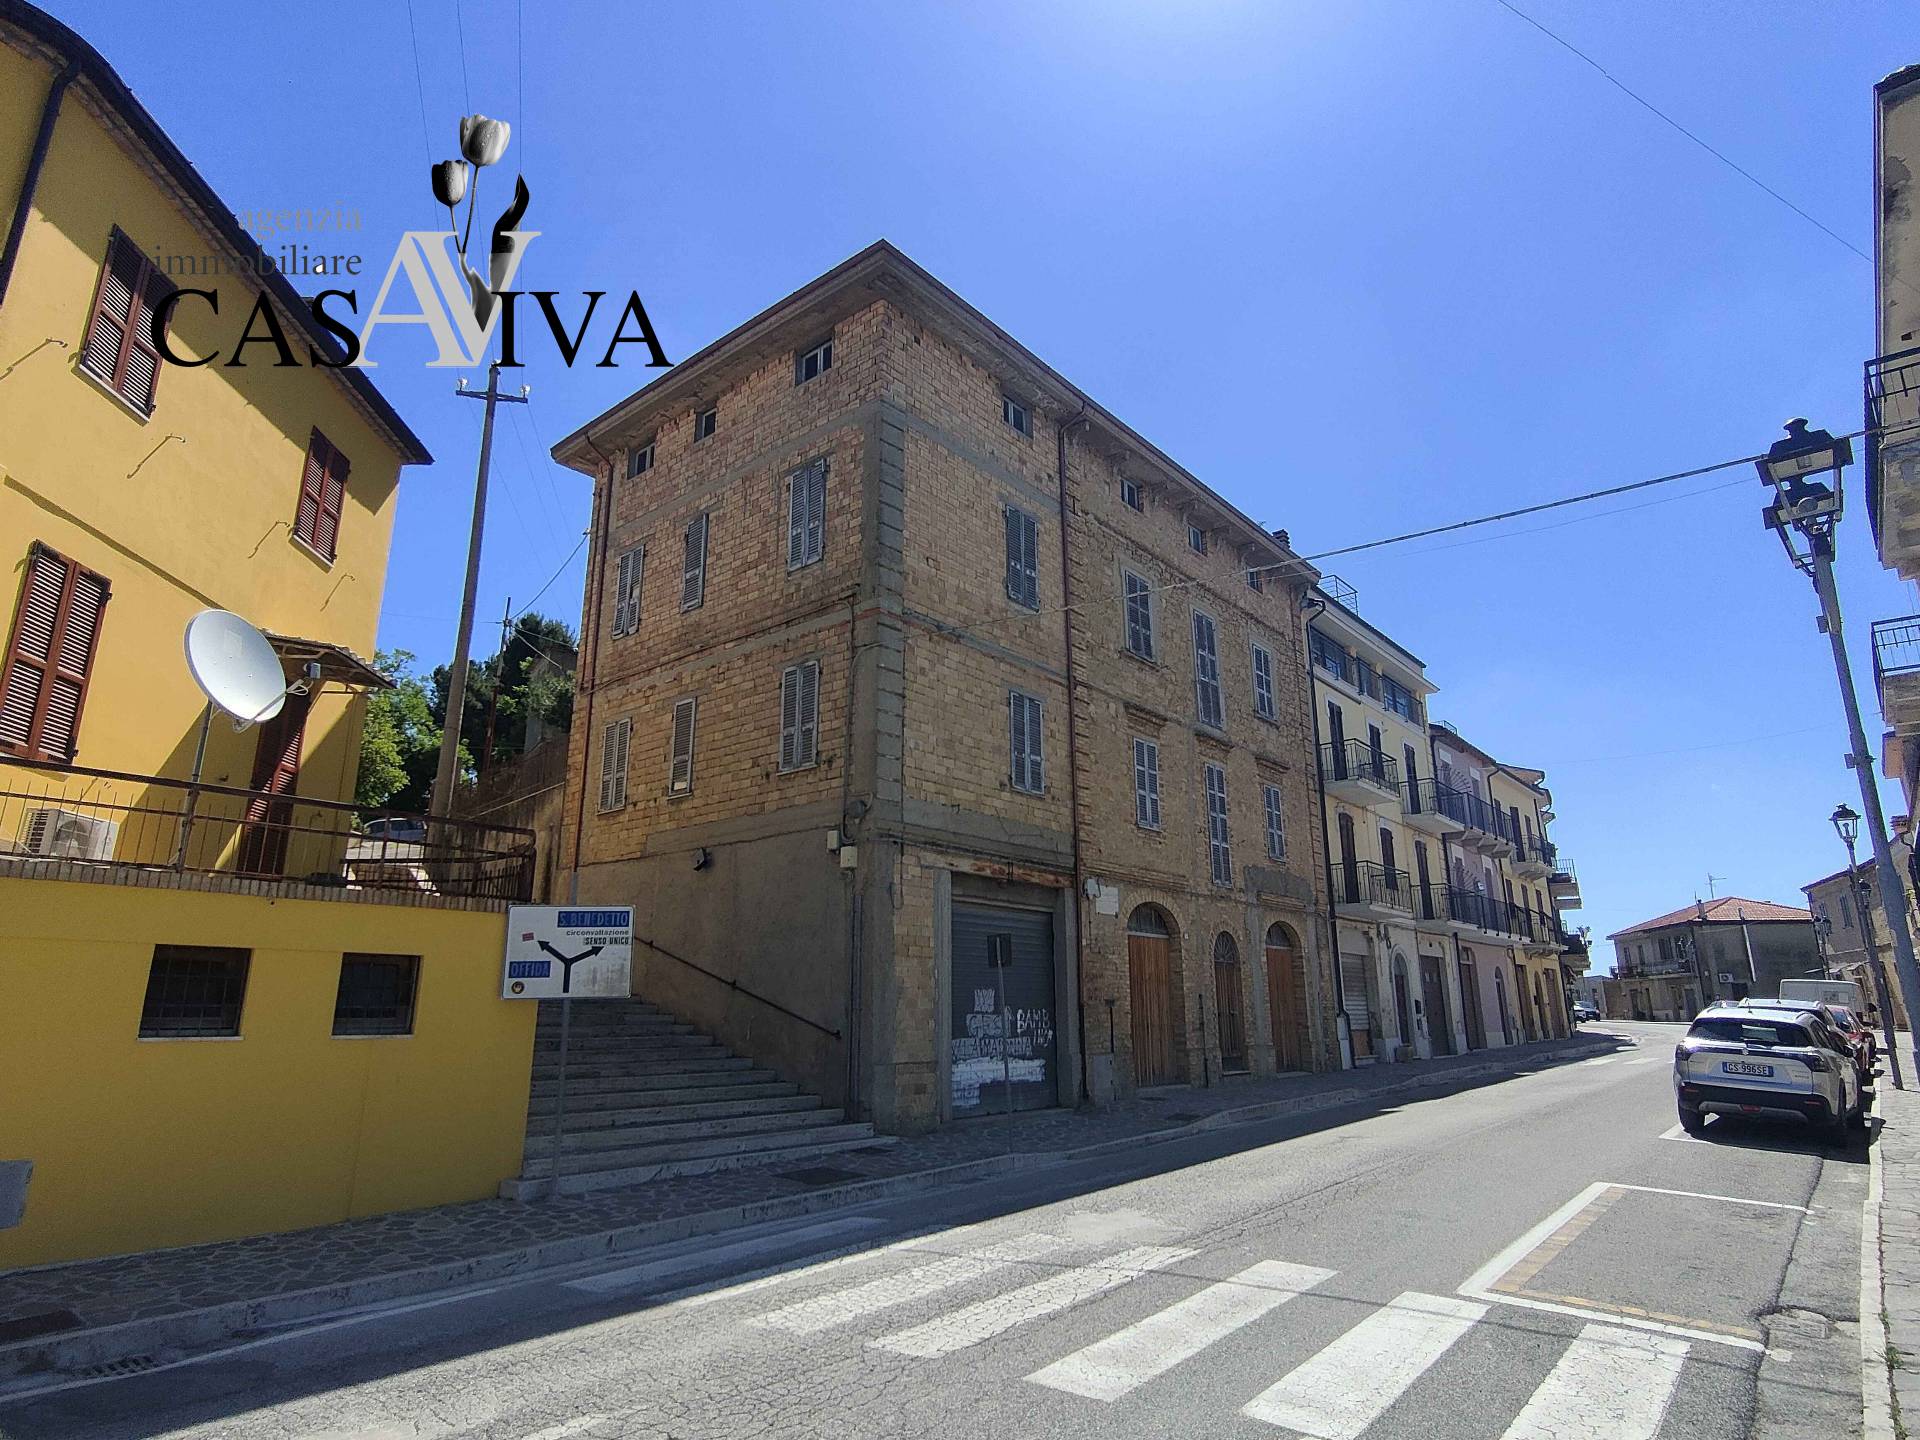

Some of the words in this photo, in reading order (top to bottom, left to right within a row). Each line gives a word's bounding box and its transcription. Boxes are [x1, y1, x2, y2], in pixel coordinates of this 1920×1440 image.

[585, 937, 607, 945] SENSO
[609, 937, 629, 945] UNICO
[511, 962, 549, 976] OFFIDA
